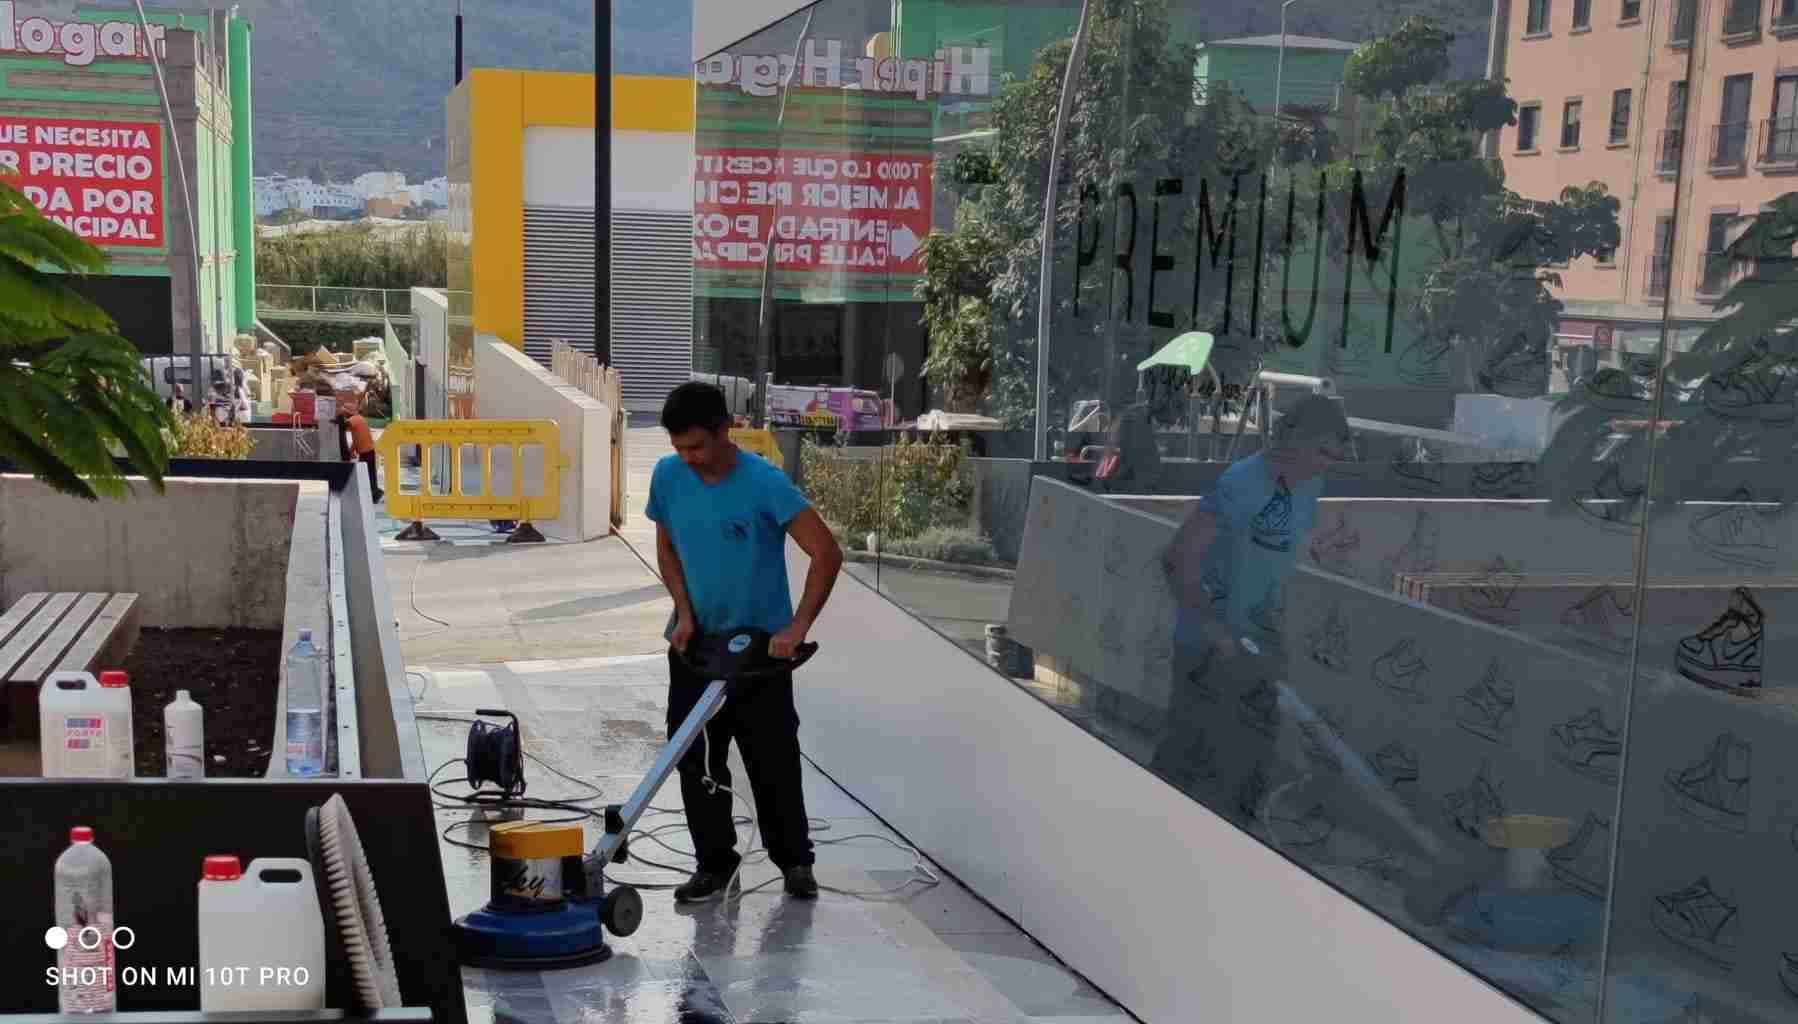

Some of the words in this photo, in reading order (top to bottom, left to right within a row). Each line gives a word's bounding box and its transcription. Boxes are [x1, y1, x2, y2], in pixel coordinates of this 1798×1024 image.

[35, 126, 151, 149] NECESITA
[29, 151, 153, 180] PRECIO
[81, 188, 154, 215] POR
[1072, 165, 1407, 355] PREMIUM
